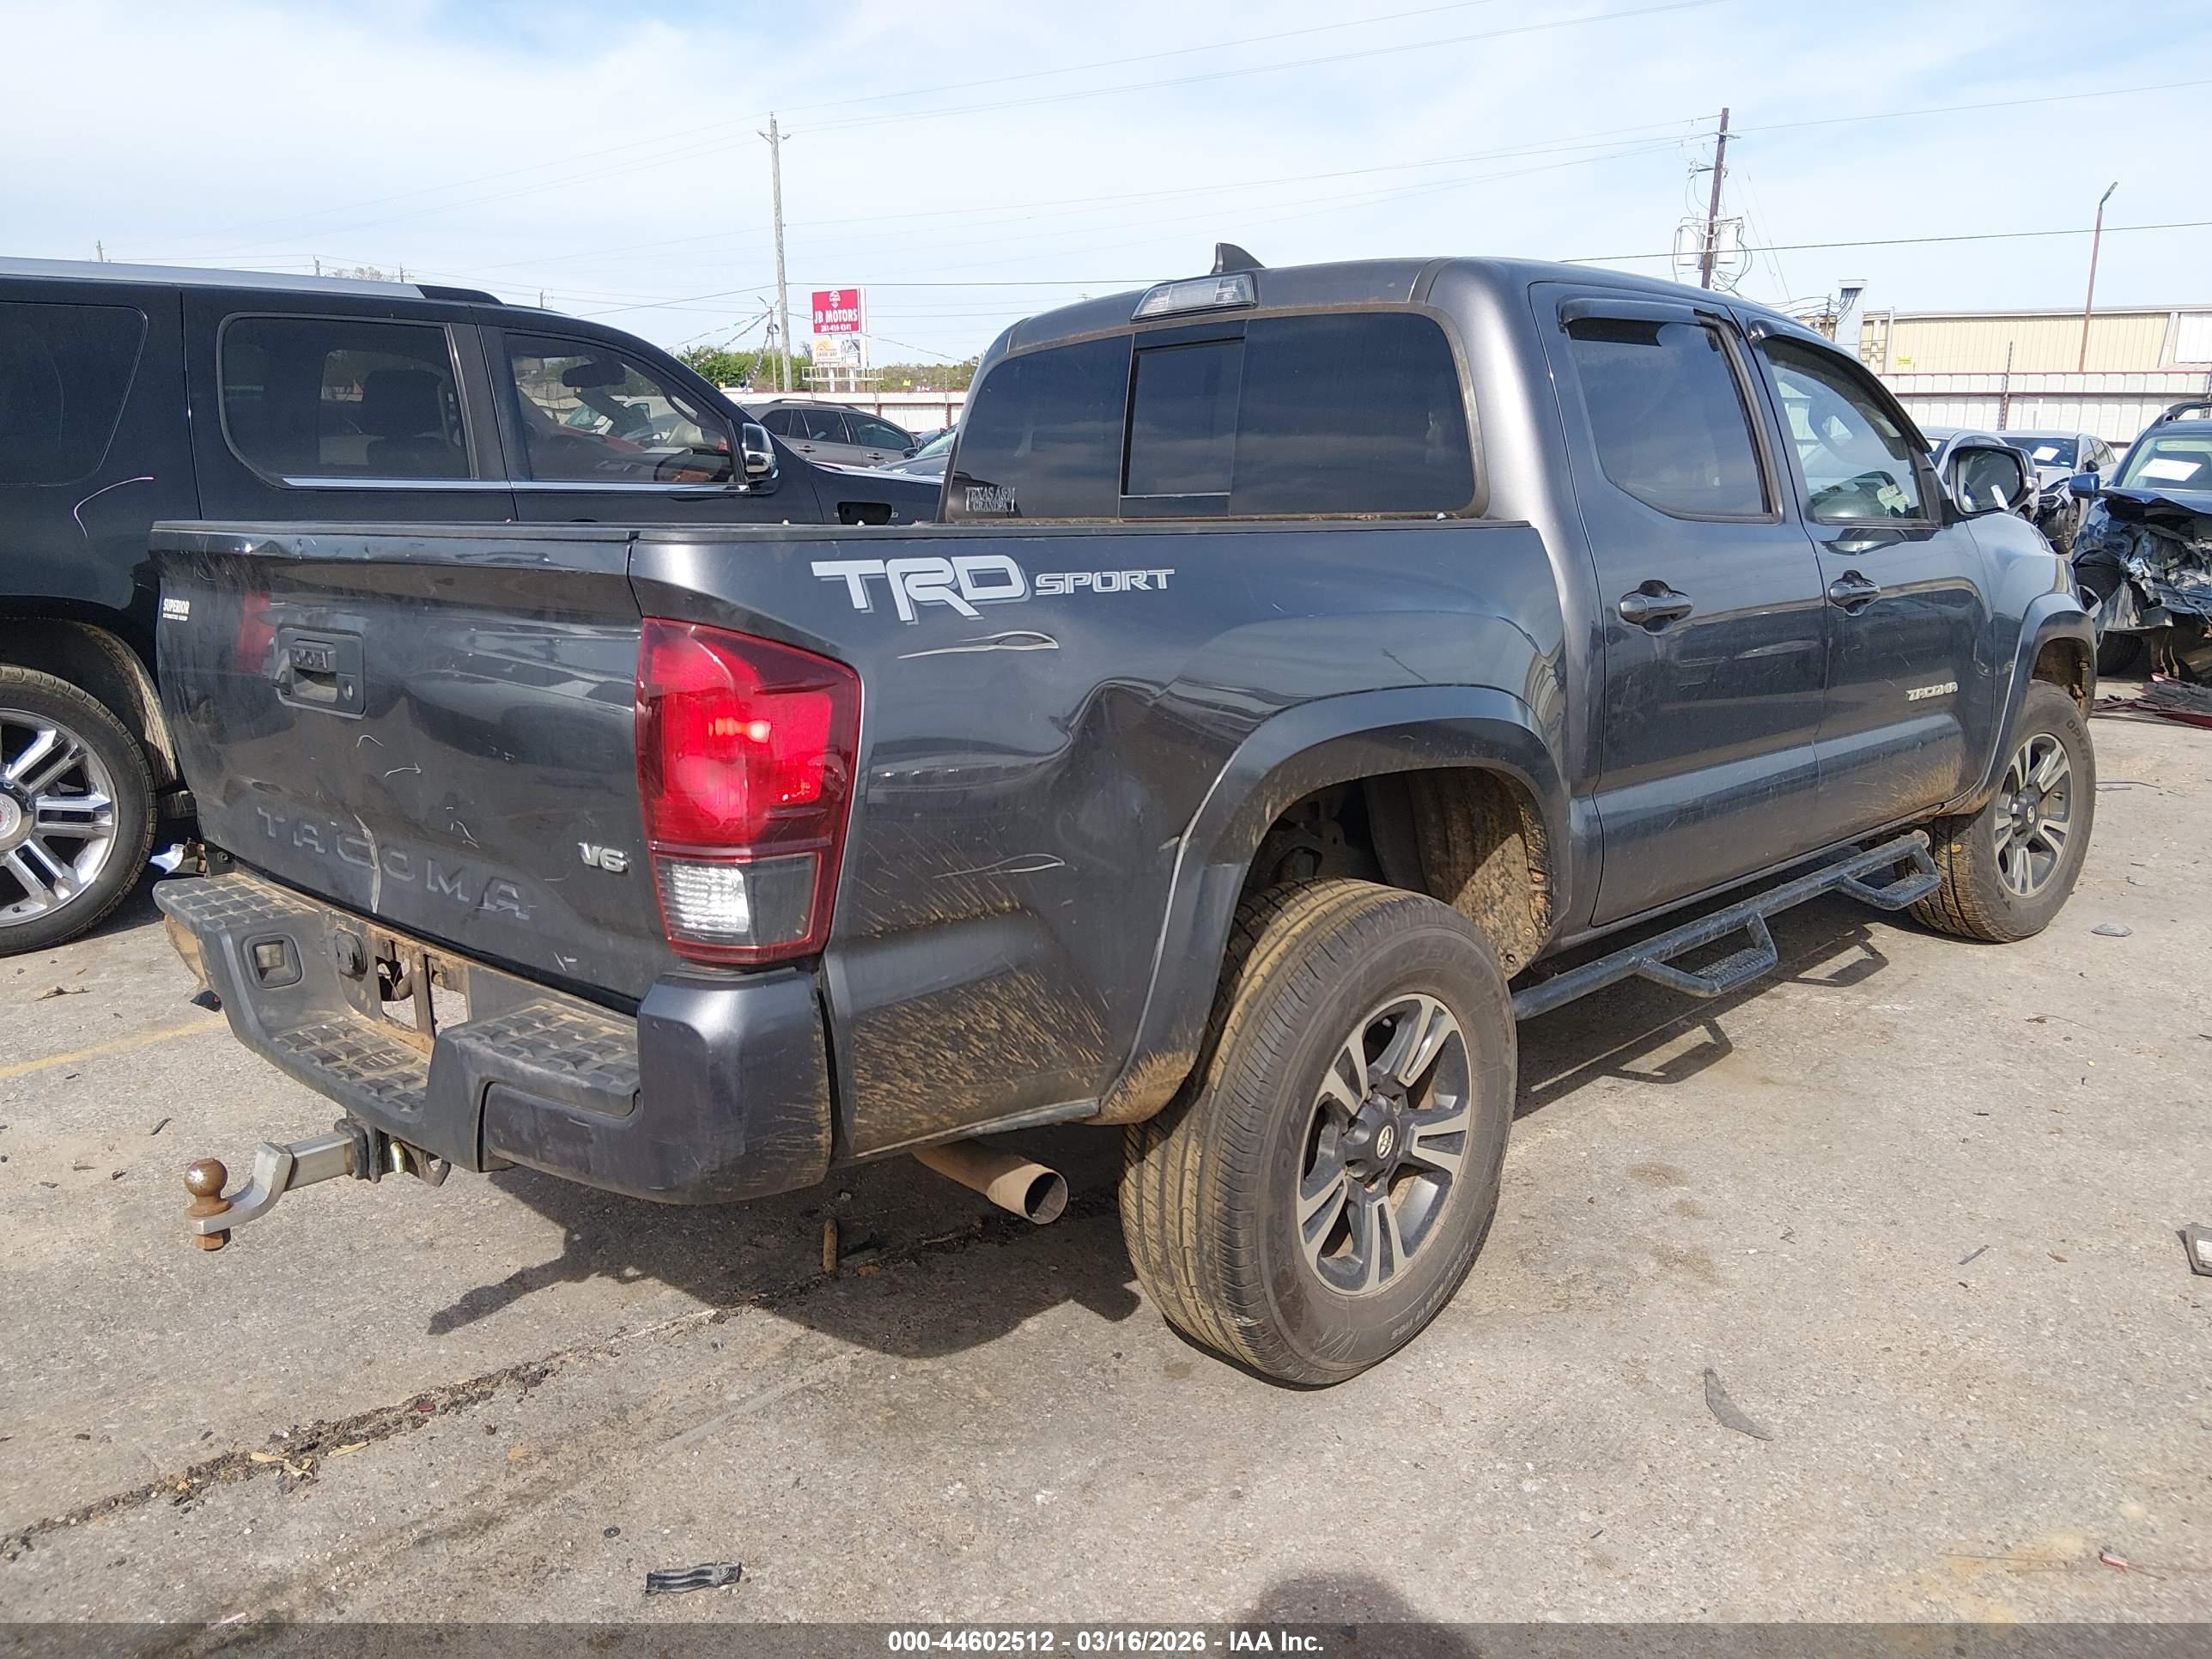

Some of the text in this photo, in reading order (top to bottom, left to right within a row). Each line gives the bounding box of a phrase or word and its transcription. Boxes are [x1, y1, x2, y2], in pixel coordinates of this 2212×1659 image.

[825, 308, 858, 324] MOTORS
[965, 487, 994, 511] TEXAS
[973, 501, 1009, 512] GRANDPA
[811, 554, 1175, 625] TRD SPORT
[162, 598, 190, 615] SUPERIOR
[257, 806, 532, 921] TACOMA
[577, 841, 632, 873] V6
